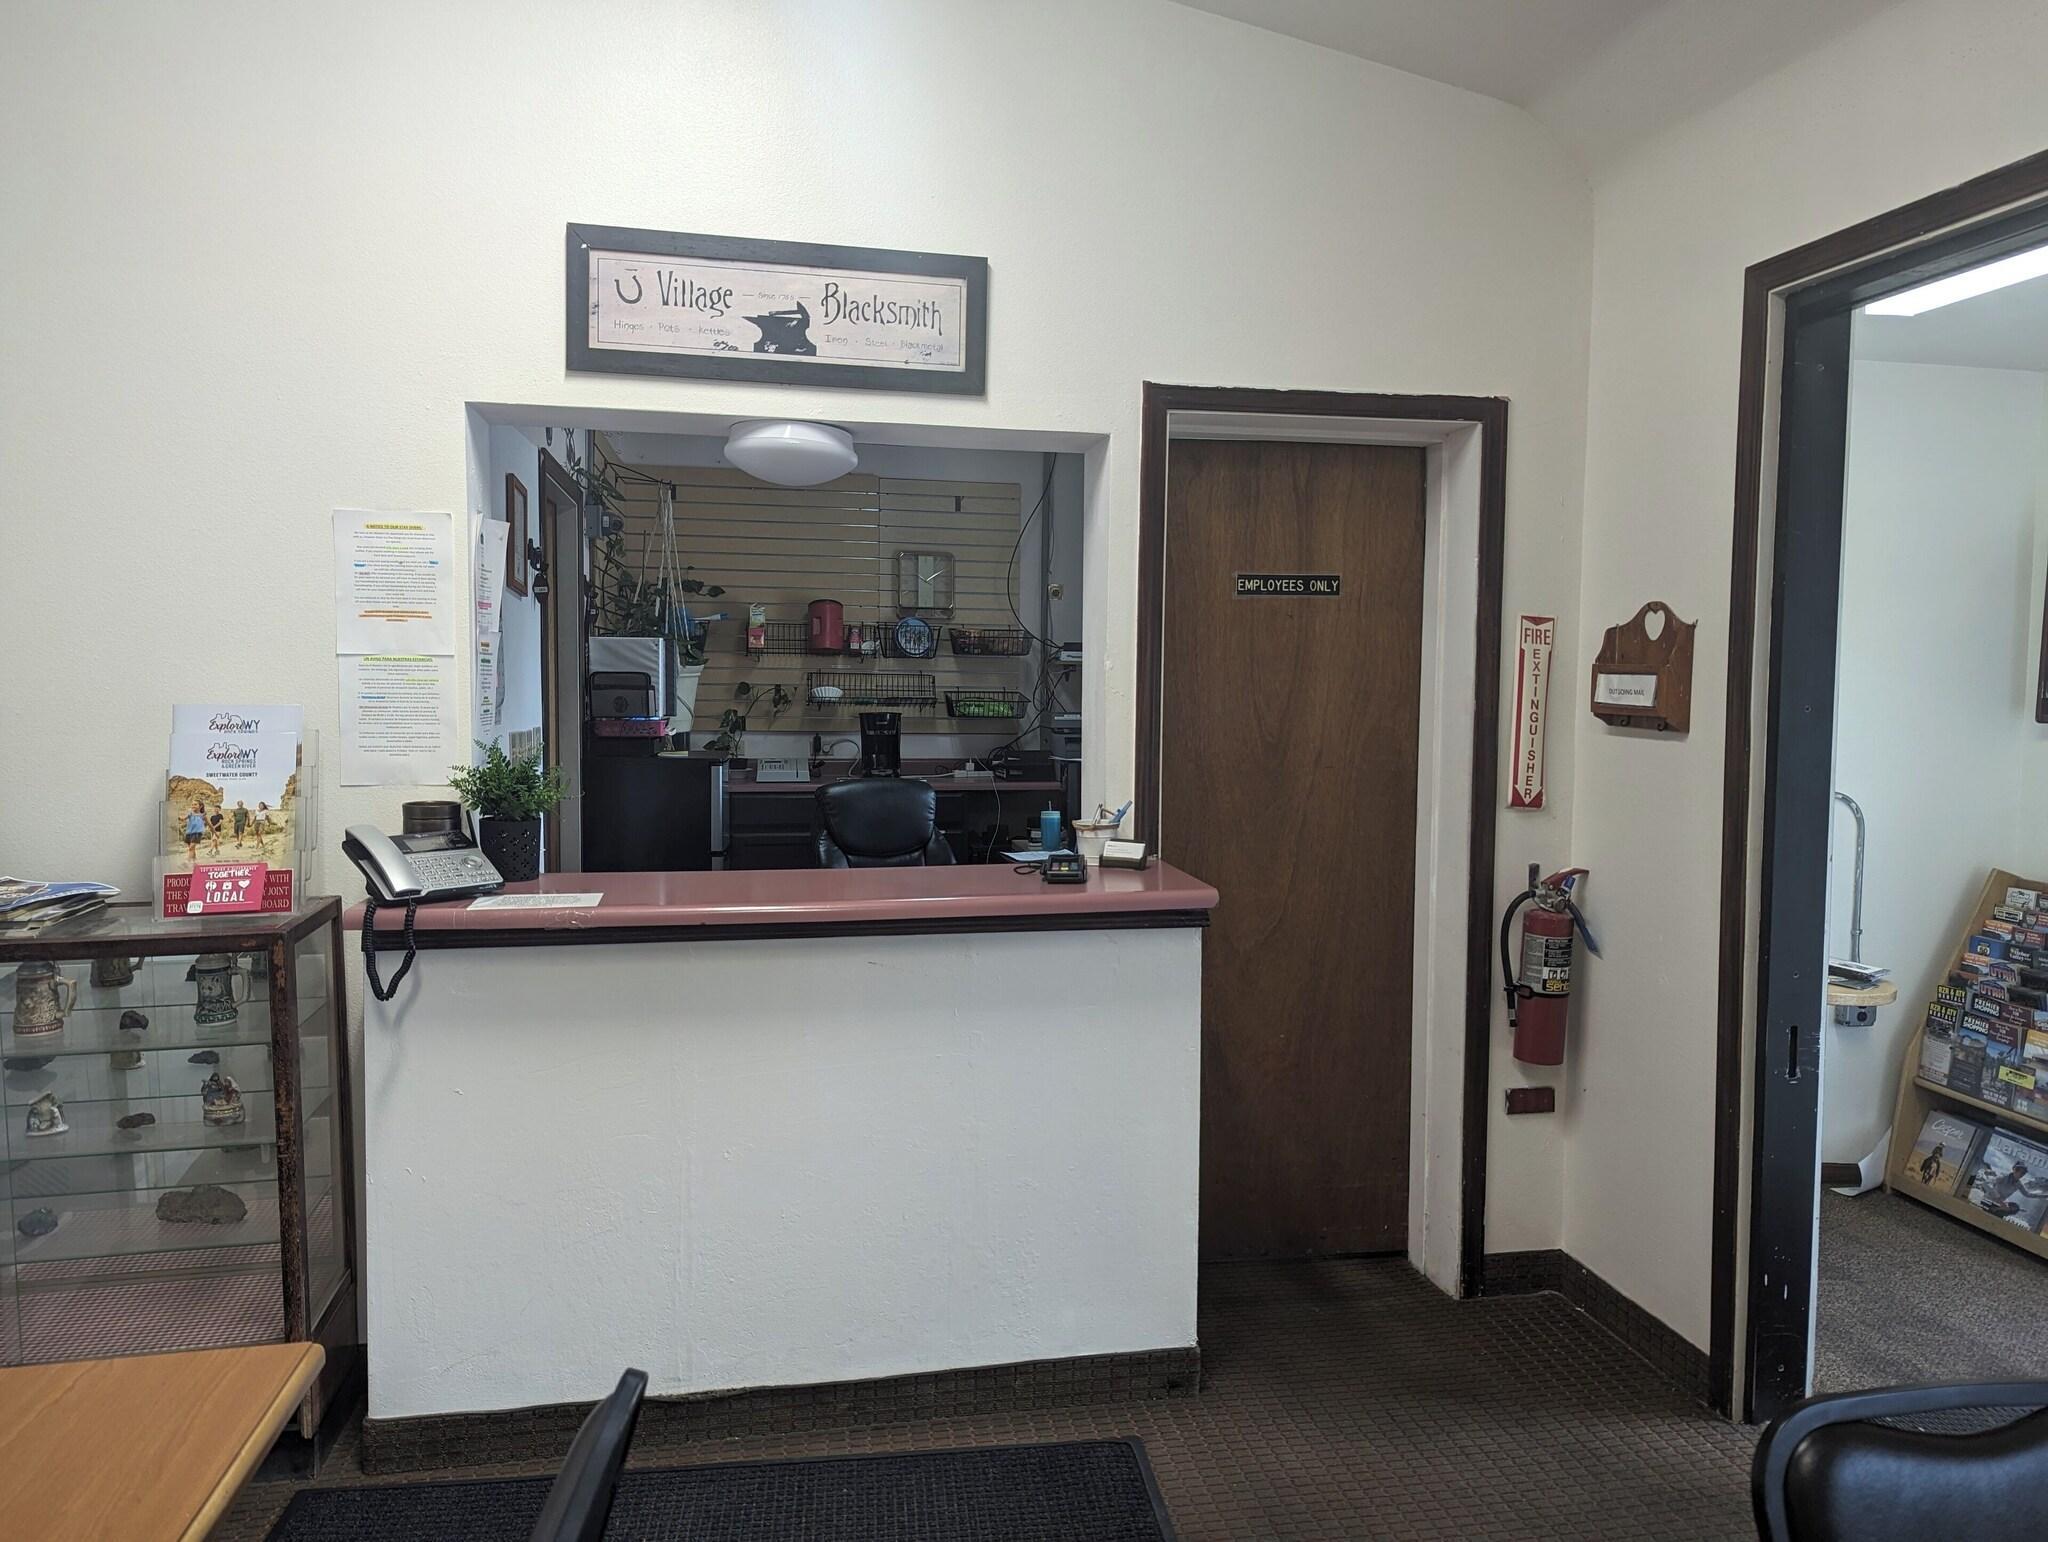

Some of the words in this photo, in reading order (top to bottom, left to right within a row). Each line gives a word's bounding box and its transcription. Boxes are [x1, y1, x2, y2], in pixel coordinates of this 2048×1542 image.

[656, 270, 734, 318] Village
[820, 281, 943, 337] Blacksmith
[613, 319, 645, 334] Hinges
[657, 321, 681, 334] Pots
[1237, 579, 1304, 592] EMPLOYEES
[1309, 580, 1339, 592] ONLY
[1523, 627, 1551, 646] FIRE
[1608, 687, 1633, 696] OUTGOING
[1633, 688, 1645, 697] MAIL
[1523, 648, 1541, 799] EXTINGUISHER
[208, 869, 252, 879] TOGETHER
[269, 873, 289, 884] WITH
[166, 890, 183, 901] THE
[268, 886, 289, 897] JOINT
[206, 890, 245, 903] LOCAL
[1980, 984, 2006, 1000] UTAH
[1929, 1009, 1956, 1023] RENTALS
